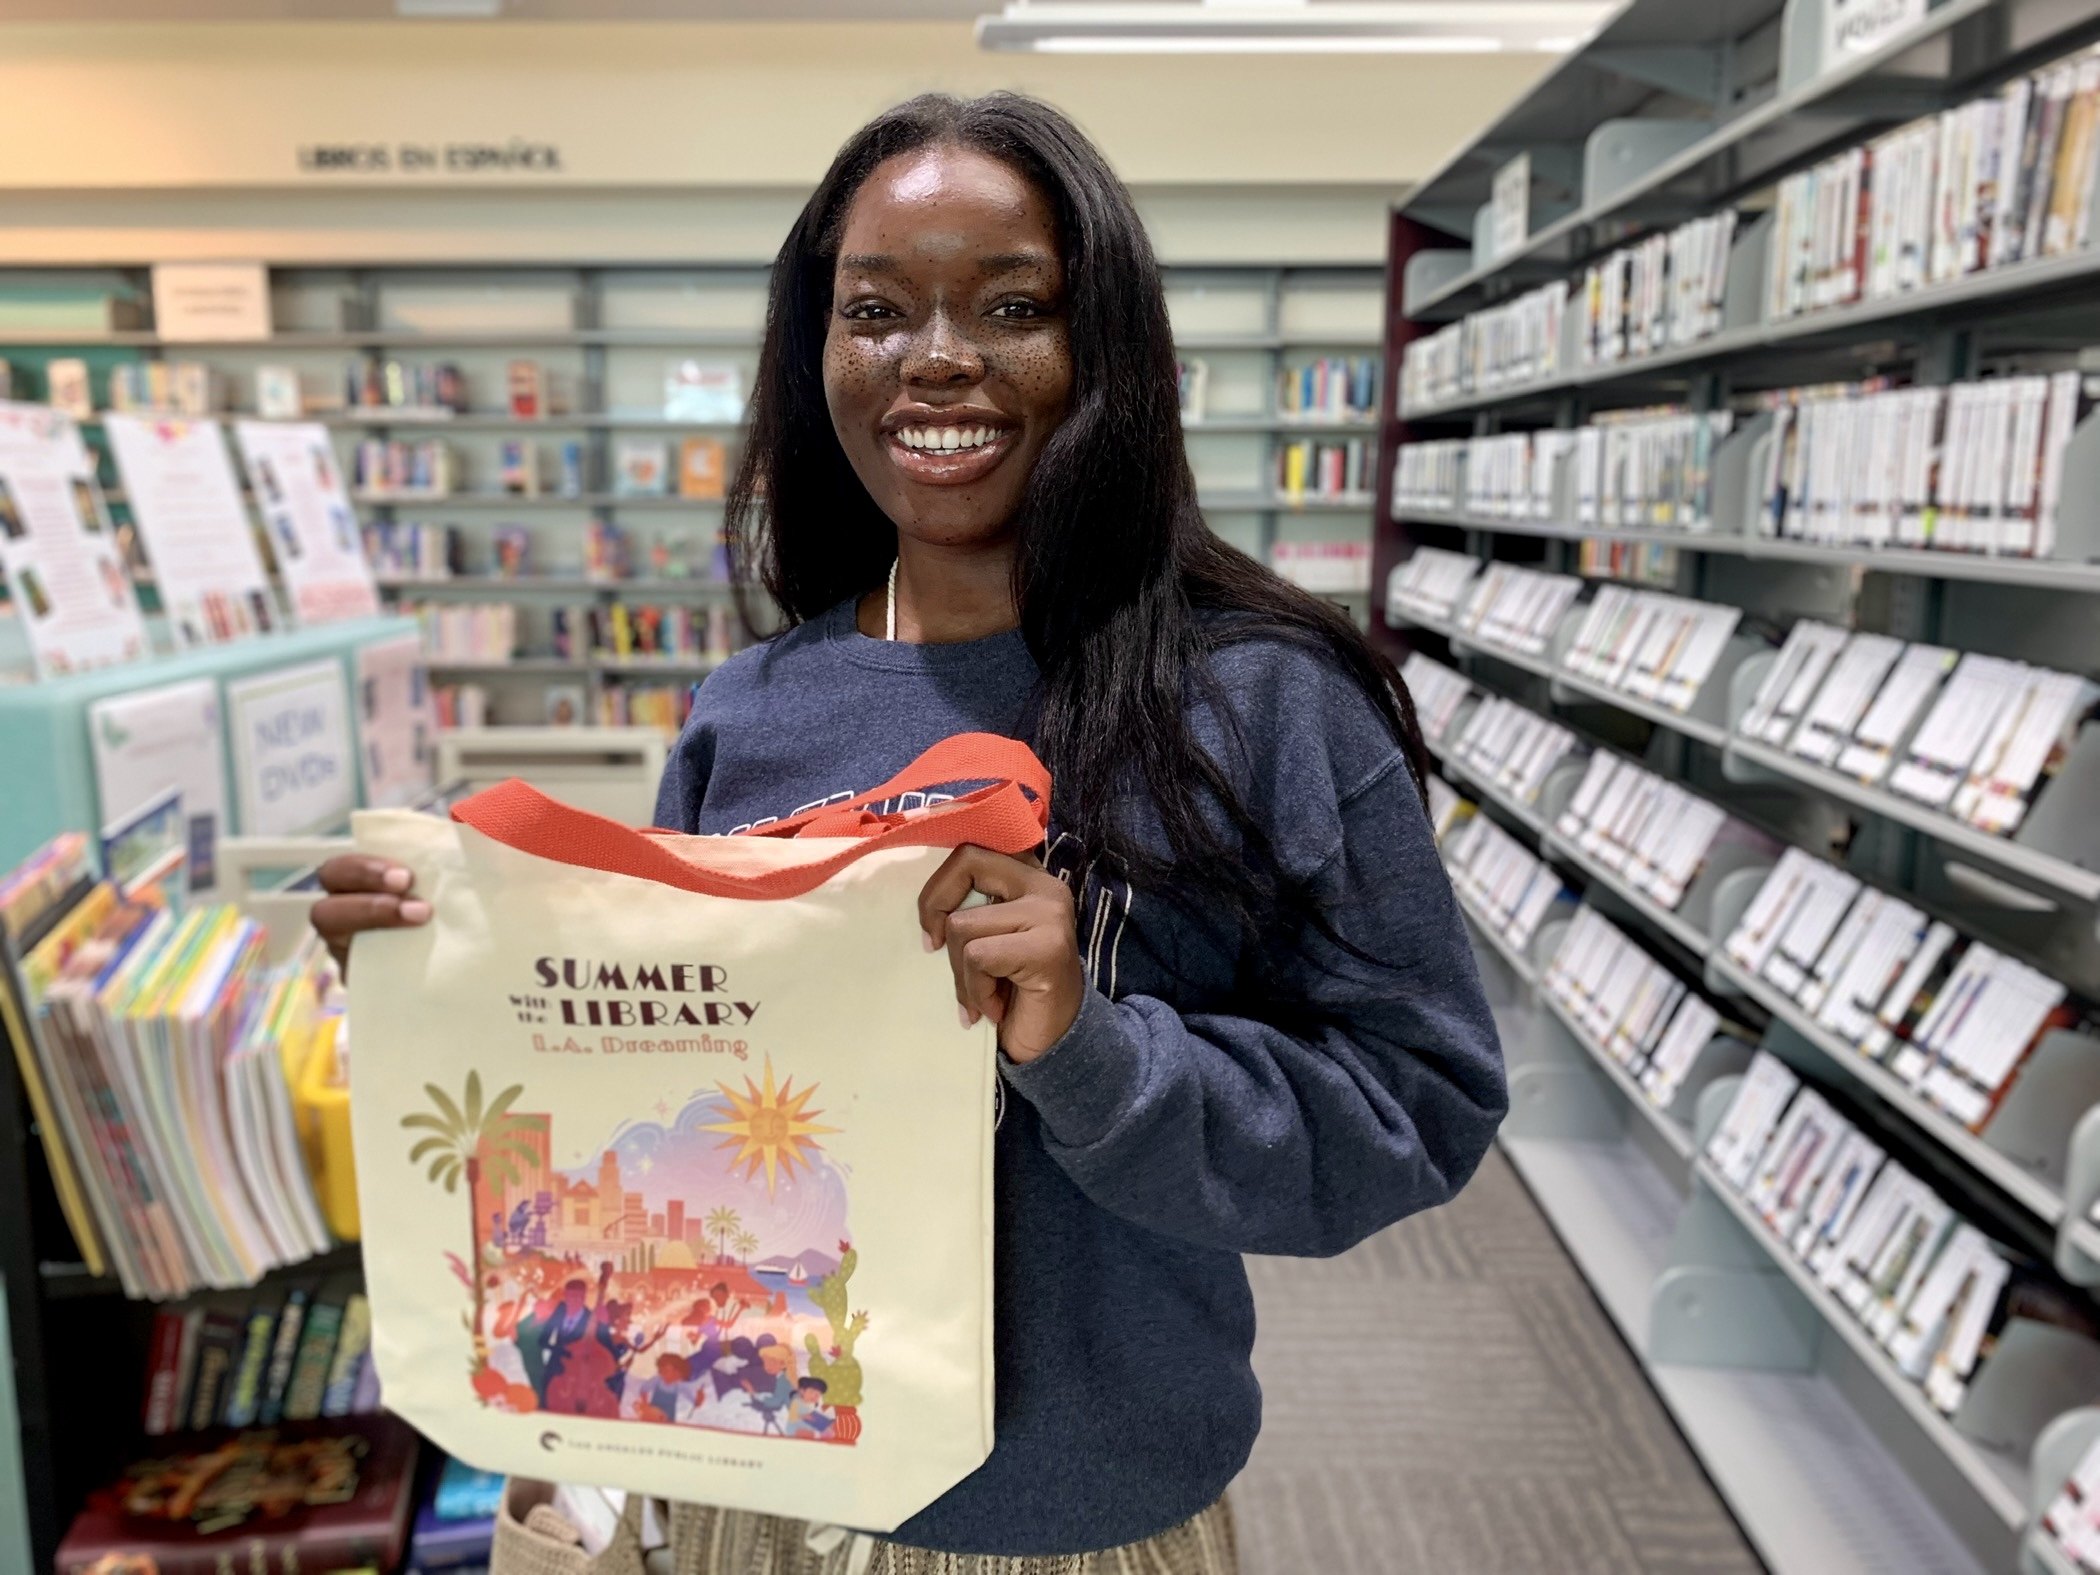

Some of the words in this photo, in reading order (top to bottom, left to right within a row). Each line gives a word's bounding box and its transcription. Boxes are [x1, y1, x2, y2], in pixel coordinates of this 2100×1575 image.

[255, 706, 325, 748] NEW
[535, 956, 728, 993] SUMMER
[561, 999, 761, 1027] LIBRARY
[532, 1033, 593, 1054] L.A.
[601, 1033, 748, 1061] Dreaming
[658, 1447, 702, 1463] PUBLIC
[708, 1455, 763, 1470] LIBRARY
